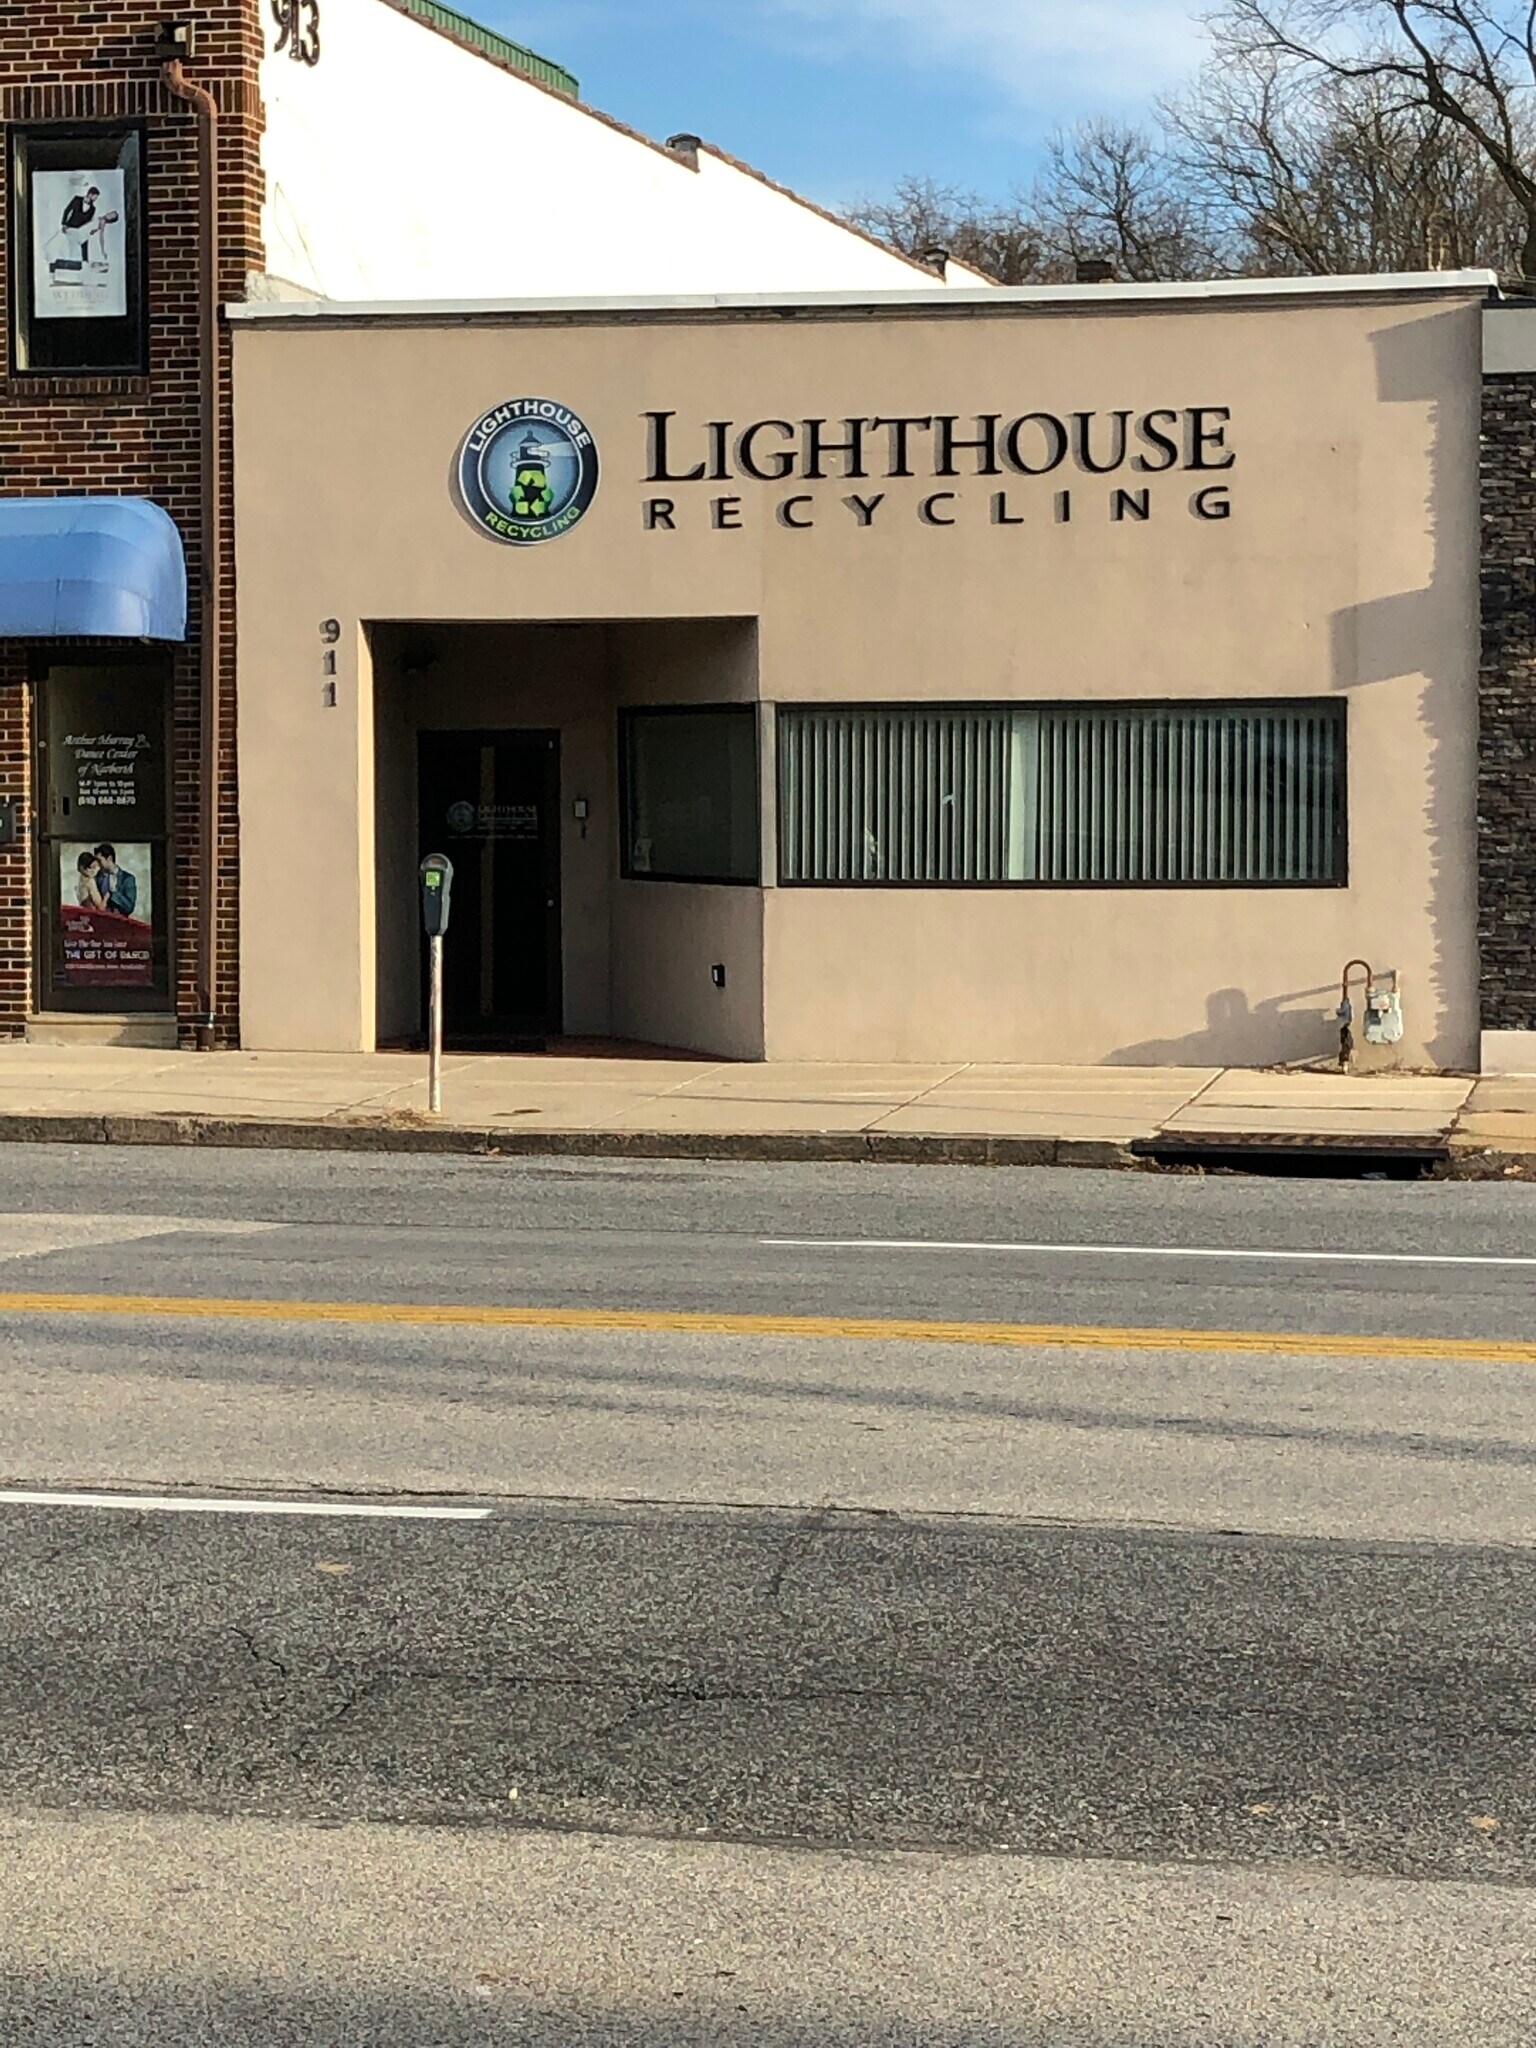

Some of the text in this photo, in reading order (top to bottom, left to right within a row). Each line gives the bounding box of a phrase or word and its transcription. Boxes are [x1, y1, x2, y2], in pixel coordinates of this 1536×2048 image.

[271, 0, 320, 67] 913
[469, 401, 592, 452] LIGHTHOUSE
[643, 407, 1235, 481] LIGHTHOUSE
[485, 506, 581, 538] RECYCLING
[645, 486, 1230, 529] RECYCLING
[320, 618, 341, 708] 911
[75, 748, 105, 759] Dance
[77, 762, 92, 777] of
